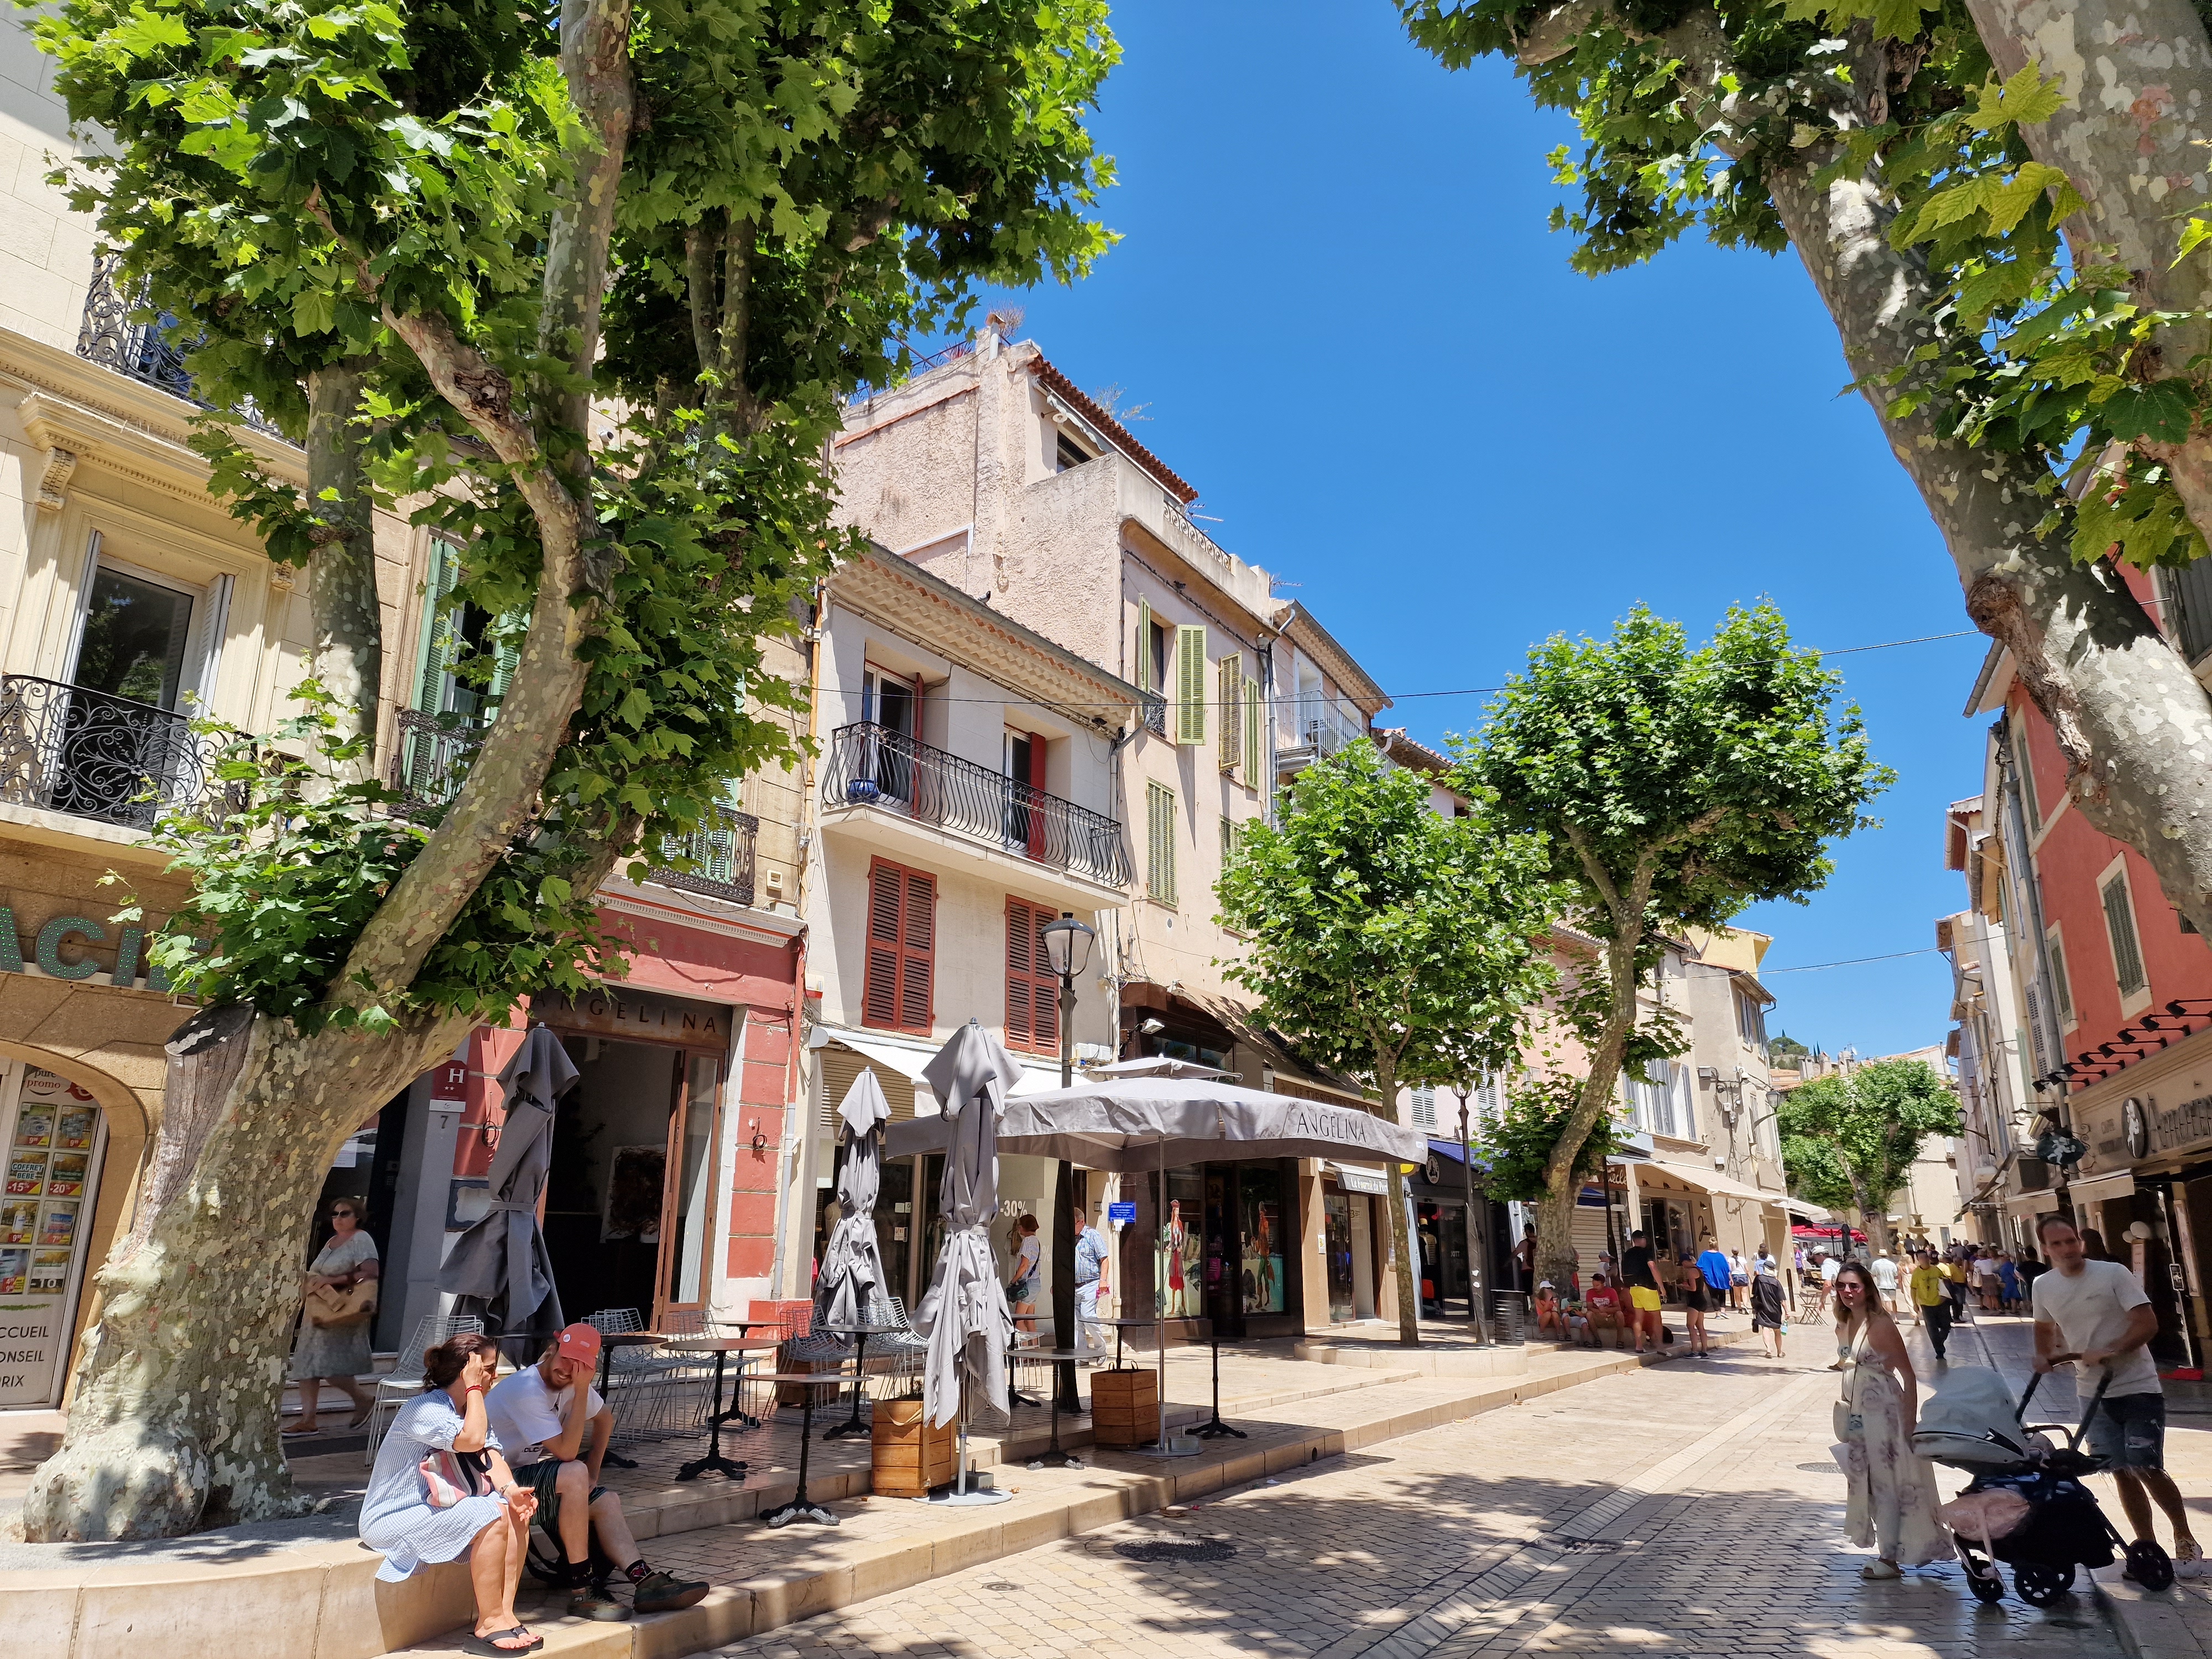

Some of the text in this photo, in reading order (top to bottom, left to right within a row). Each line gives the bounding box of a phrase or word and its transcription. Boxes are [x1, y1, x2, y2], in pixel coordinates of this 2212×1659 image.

[531, 990, 716, 1033] ANGELINA
[447, 1068, 466, 1083] H
[27, 1079, 61, 1088] promo
[441, 1115, 448, 1129] 7
[1297, 1112, 1366, 1142] ANGELINA
[8, 1182, 29, 1192] -15%
[50, 1183, 71, 1193] -20%
[1000, 1200, 1027, 1217] -30%
[0, 1375, 25, 1387] RIX
